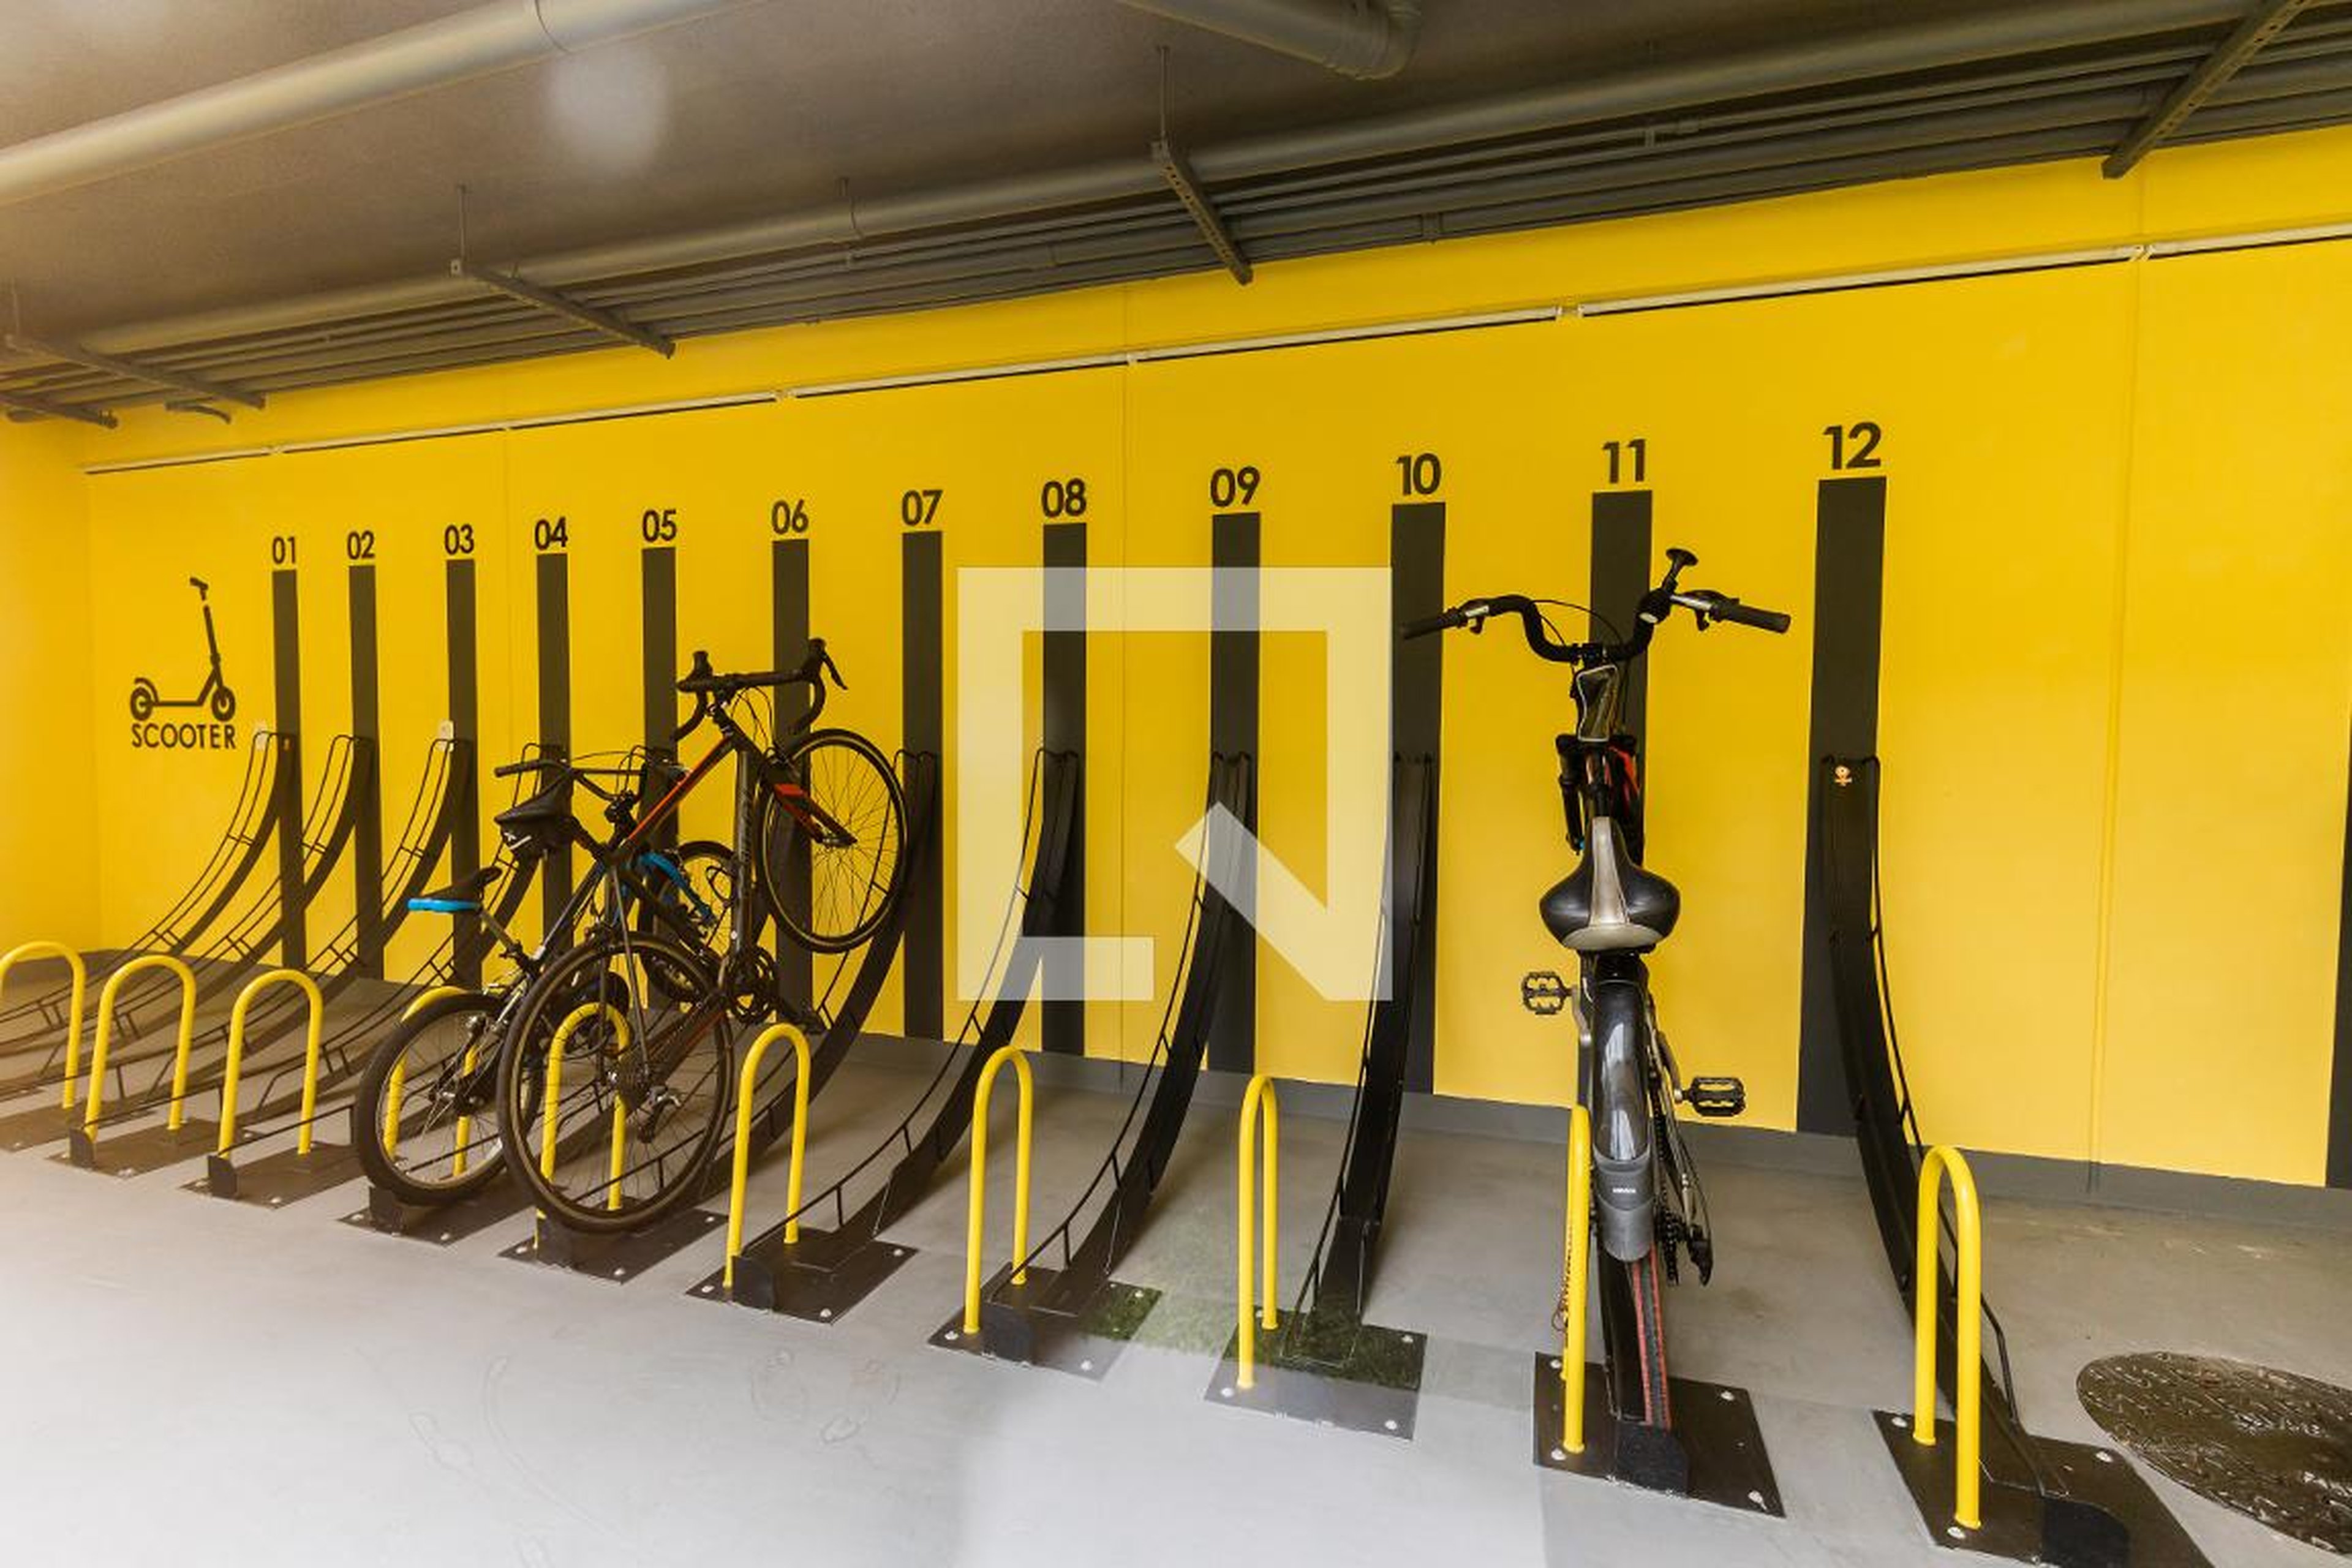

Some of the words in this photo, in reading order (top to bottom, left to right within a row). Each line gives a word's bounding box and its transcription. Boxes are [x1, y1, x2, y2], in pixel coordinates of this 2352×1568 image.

[1602, 439, 1646, 484] 11
[1823, 421, 1881, 470] 12
[1210, 466, 1261, 508] 09
[1396, 453, 1442, 496] 10
[902, 489, 943, 527] 07
[1041, 478, 1087, 519] 08
[534, 516, 568, 551] 04
[642, 508, 677, 543] 05
[771, 499, 809, 535] 06
[272, 536, 296, 565] 01
[347, 530, 375, 560] 02
[444, 524, 475, 556] 03
[131, 723, 236, 749] SCOOTER
